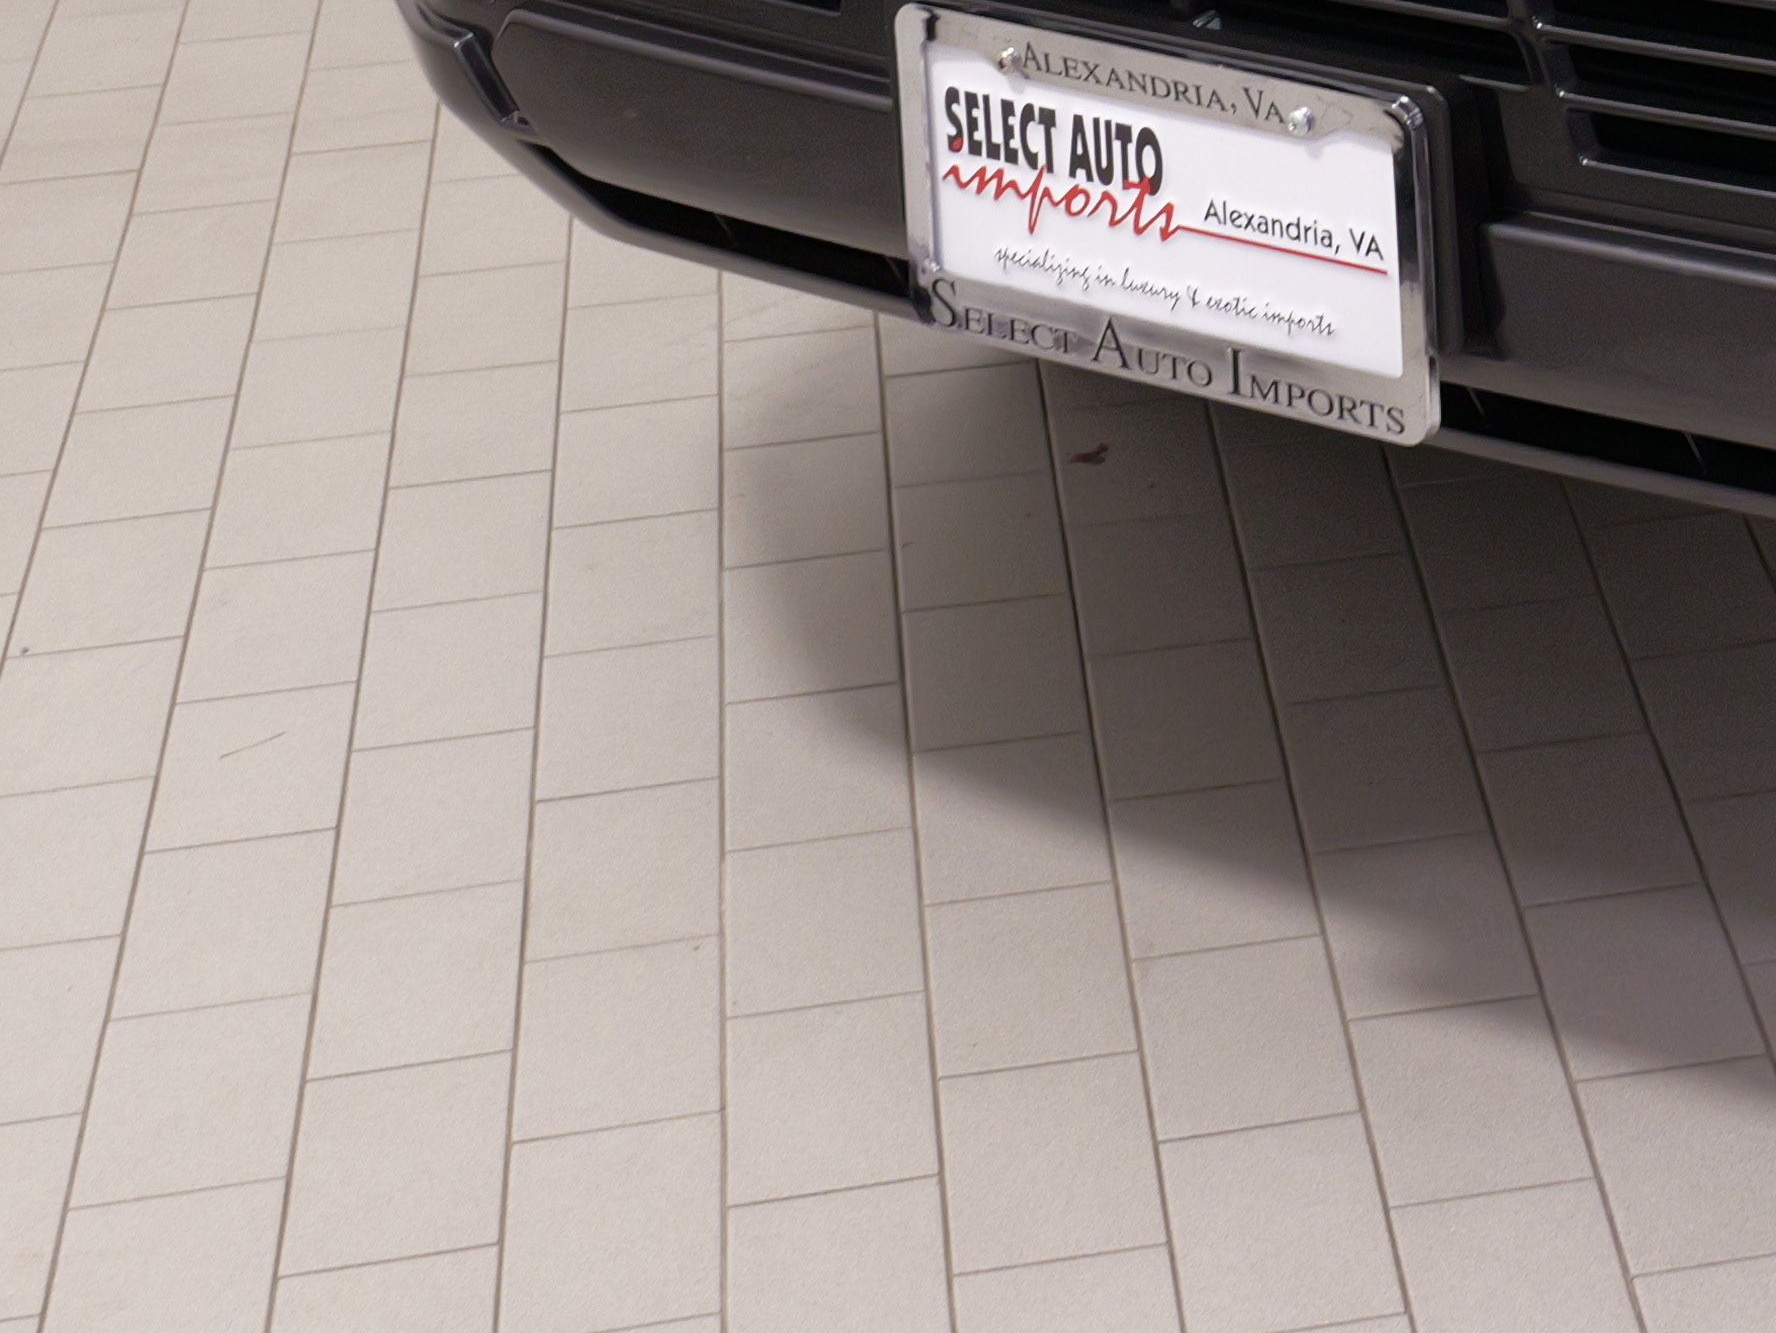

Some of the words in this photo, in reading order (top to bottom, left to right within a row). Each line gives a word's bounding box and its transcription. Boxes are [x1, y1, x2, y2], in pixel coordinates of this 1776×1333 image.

[944, 86, 1057, 173] SELECT
[1068, 113, 1164, 196] AUTO
[942, 164, 1178, 242] imports
[1204, 199, 1341, 255] Alexandria,
[1349, 227, 1384, 261] VA
[995, 246, 1091, 290] specializing
[1096, 265, 1118, 287] in
[1121, 267, 1183, 312] luxury
[1207, 294, 1259, 321] exotic
[1262, 302, 1337, 341] imports
